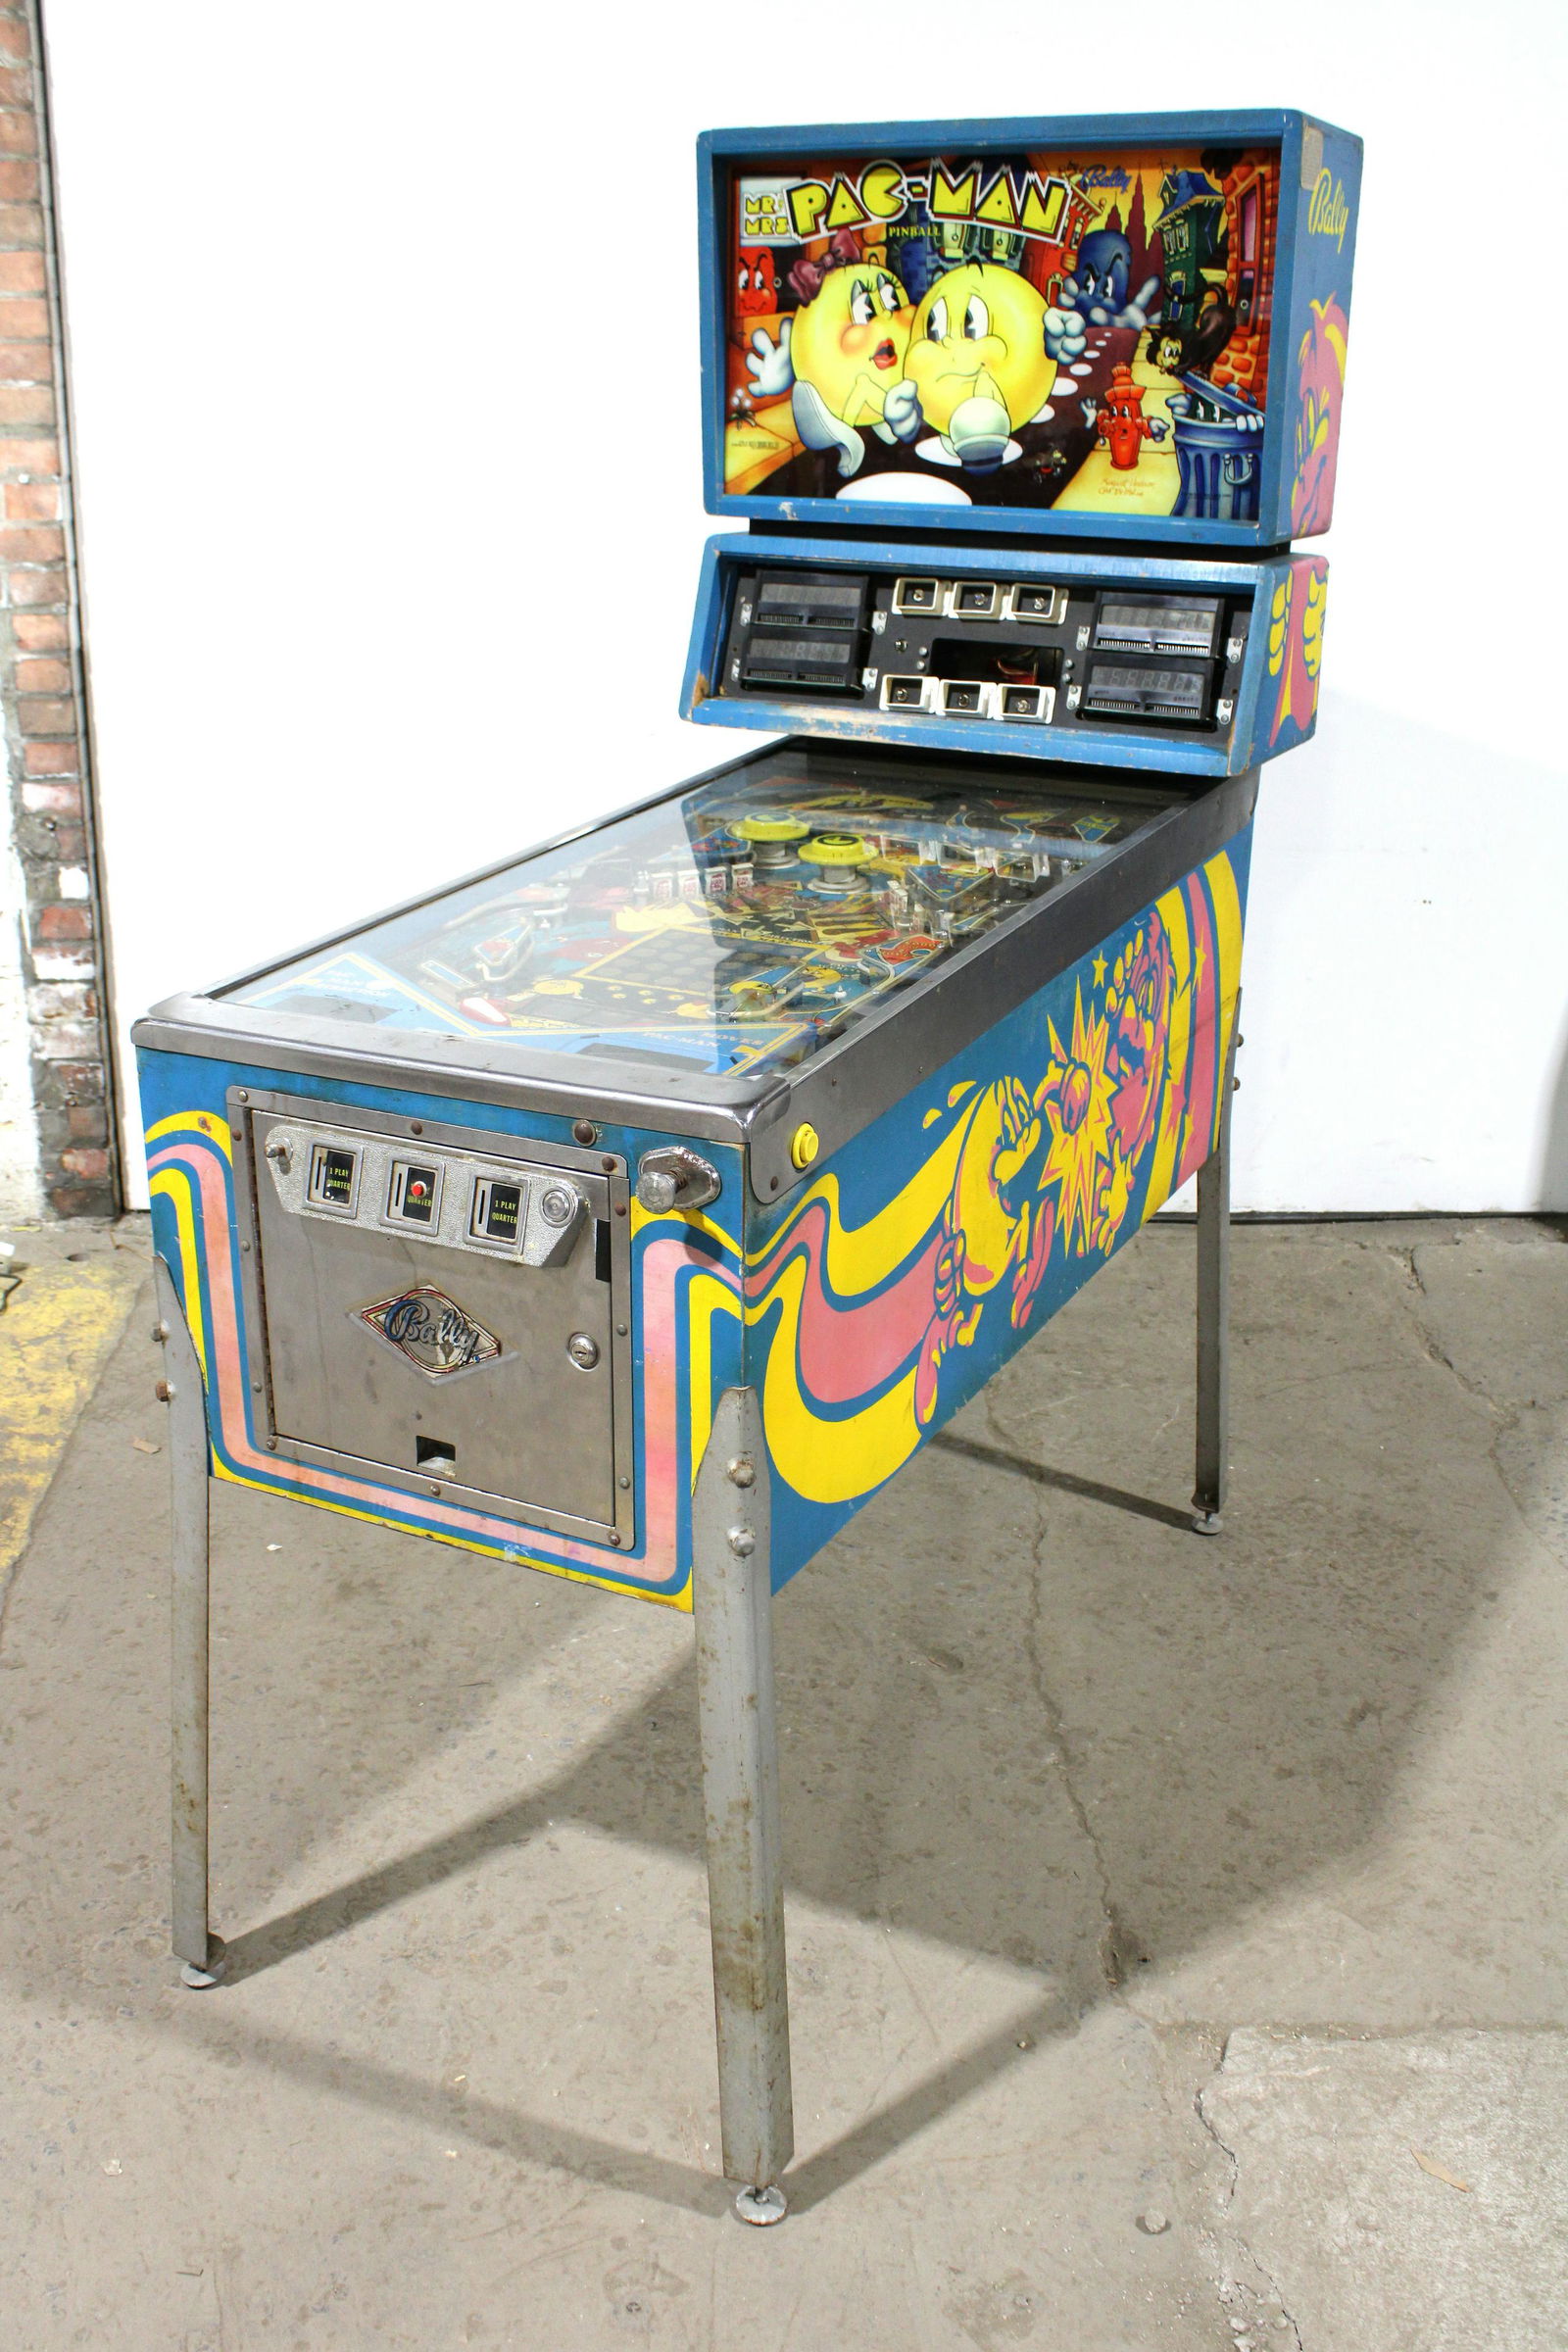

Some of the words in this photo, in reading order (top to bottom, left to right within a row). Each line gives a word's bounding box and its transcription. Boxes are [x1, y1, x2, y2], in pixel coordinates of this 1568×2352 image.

[1080, 164, 1132, 194] Bally
[785, 158, 1070, 242] PAC-MAN
[1308, 168, 1348, 254] Bally
[745, 217, 788, 235] MRS
[888, 225, 941, 238] PINBALL
[334, 1167, 349, 1178] PLAY
[326, 1178, 351, 1192] QUARTER
[407, 1195, 432, 1208] QUARTER
[494, 1199, 499, 1208] 1
[500, 1200, 517, 1211] PLAY
[491, 1215, 517, 1224] QUARTER
[383, 1298, 479, 1368] Bally
